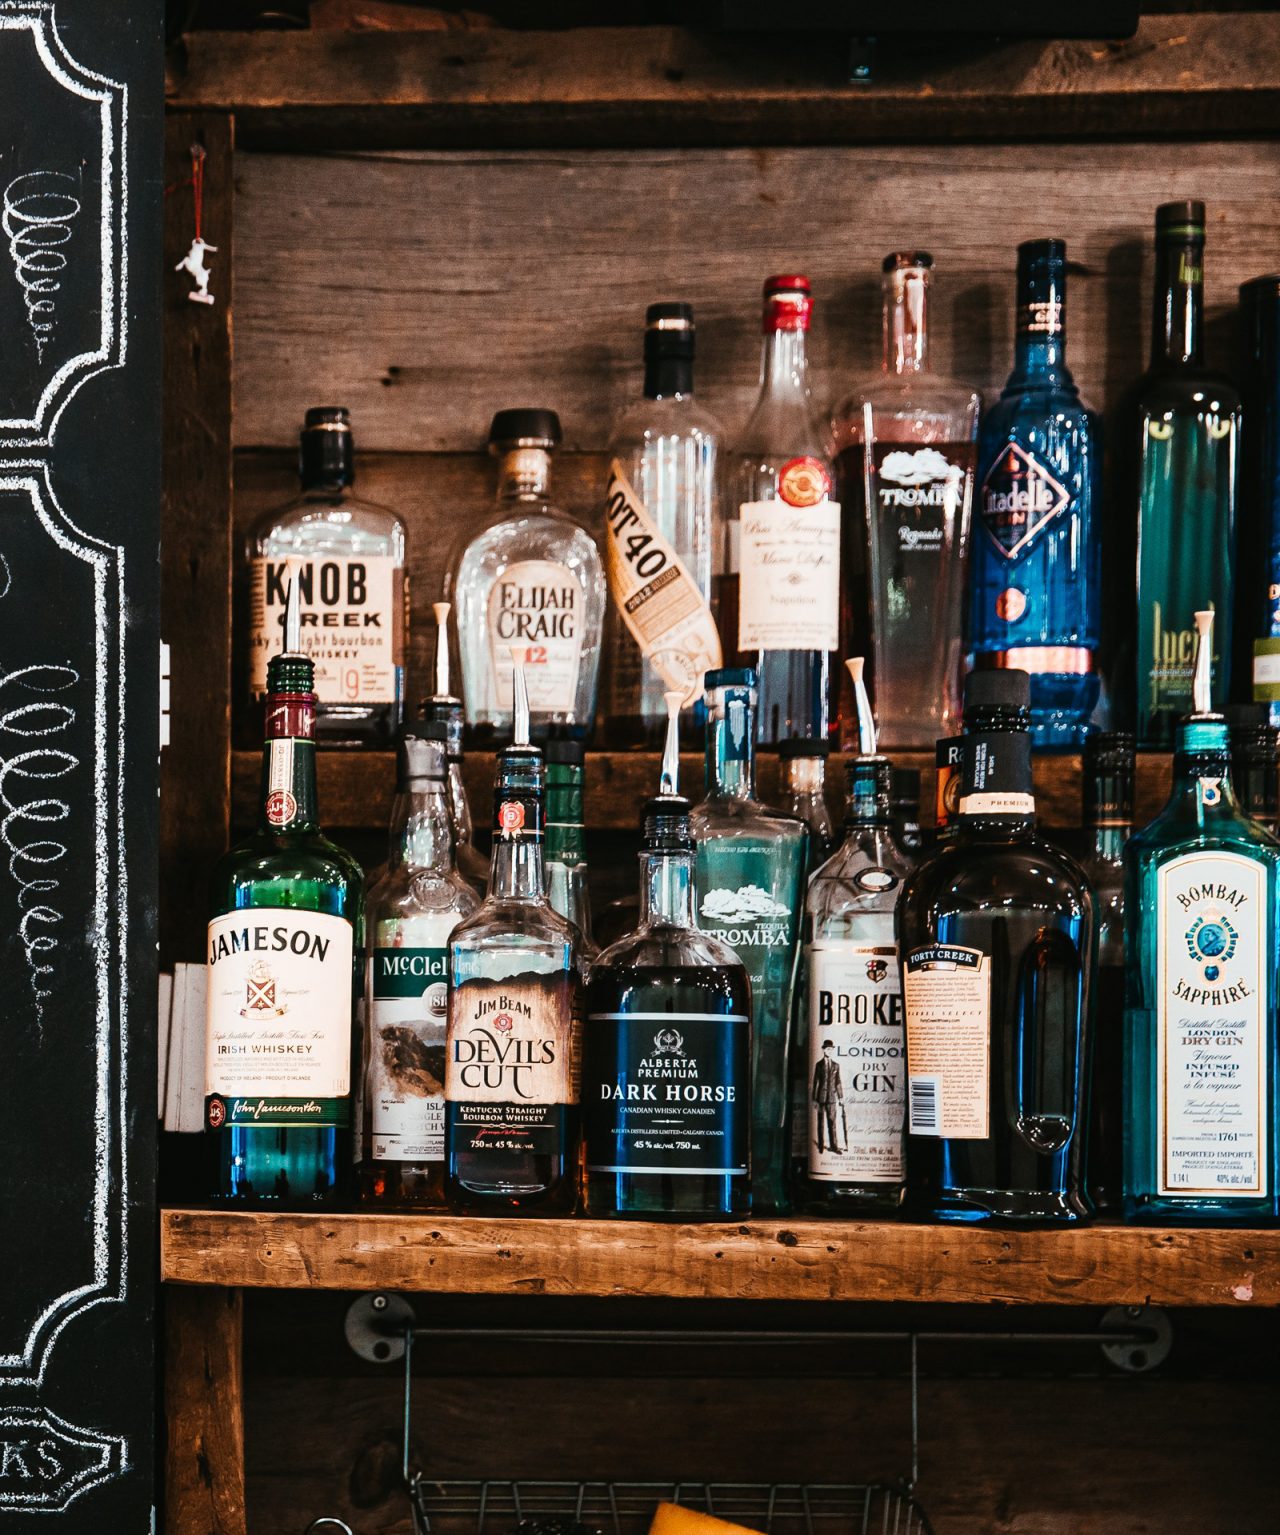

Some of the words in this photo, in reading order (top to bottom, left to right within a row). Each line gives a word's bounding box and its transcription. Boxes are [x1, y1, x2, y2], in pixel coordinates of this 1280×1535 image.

[266, 563, 367, 606] KNOB
[501, 582, 574, 612] ELIJAH
[497, 609, 574, 641] CRAIG
[332, 631, 383, 646] bourbon
[524, 647, 548, 664] 12
[345, 669, 359, 699] 9
[1176, 884, 1248, 912] BOMBAY
[210, 927, 331, 966] JAMESON
[700, 929, 790, 947] TROMBA
[910, 950, 935, 963] FORTY
[937, 950, 974, 963] CREEK
[383, 956, 448, 976] McClel
[1172, 978, 1252, 1005] SAPPHIRE
[474, 1000, 497, 1020] JIM
[499, 995, 531, 1019] BEAM
[819, 990, 902, 1026] BROKE
[218, 1045, 246, 1054] IRISH
[251, 1044, 313, 1054] WHISKEY
[454, 1028, 555, 1064] DEVIL'S
[1181, 1037, 1212, 1045] DRY
[1215, 1037, 1244, 1046] GIN
[640, 1059, 697, 1068] ALBERTA
[1193, 1050, 1232, 1063] Vapour
[638, 1069, 698, 1078] PREMIUM
[862, 1063, 889, 1071] DRY
[460, 1064, 535, 1099] CUT
[852, 1073, 896, 1092] GIN
[1206, 1083, 1242, 1092] vapeur
[601, 1084, 657, 1100] DARK
[665, 1085, 736, 1102] HORSE
[460, 1106, 503, 1114] KENTUCKY
[505, 1107, 548, 1115] STRAIGHT
[463, 1113, 503, 1121] BOURBON
[506, 1114, 545, 1122] WHISKEY
[470, 1140, 485, 1148] 750
[1219, 1132, 1238, 1141] 1761
